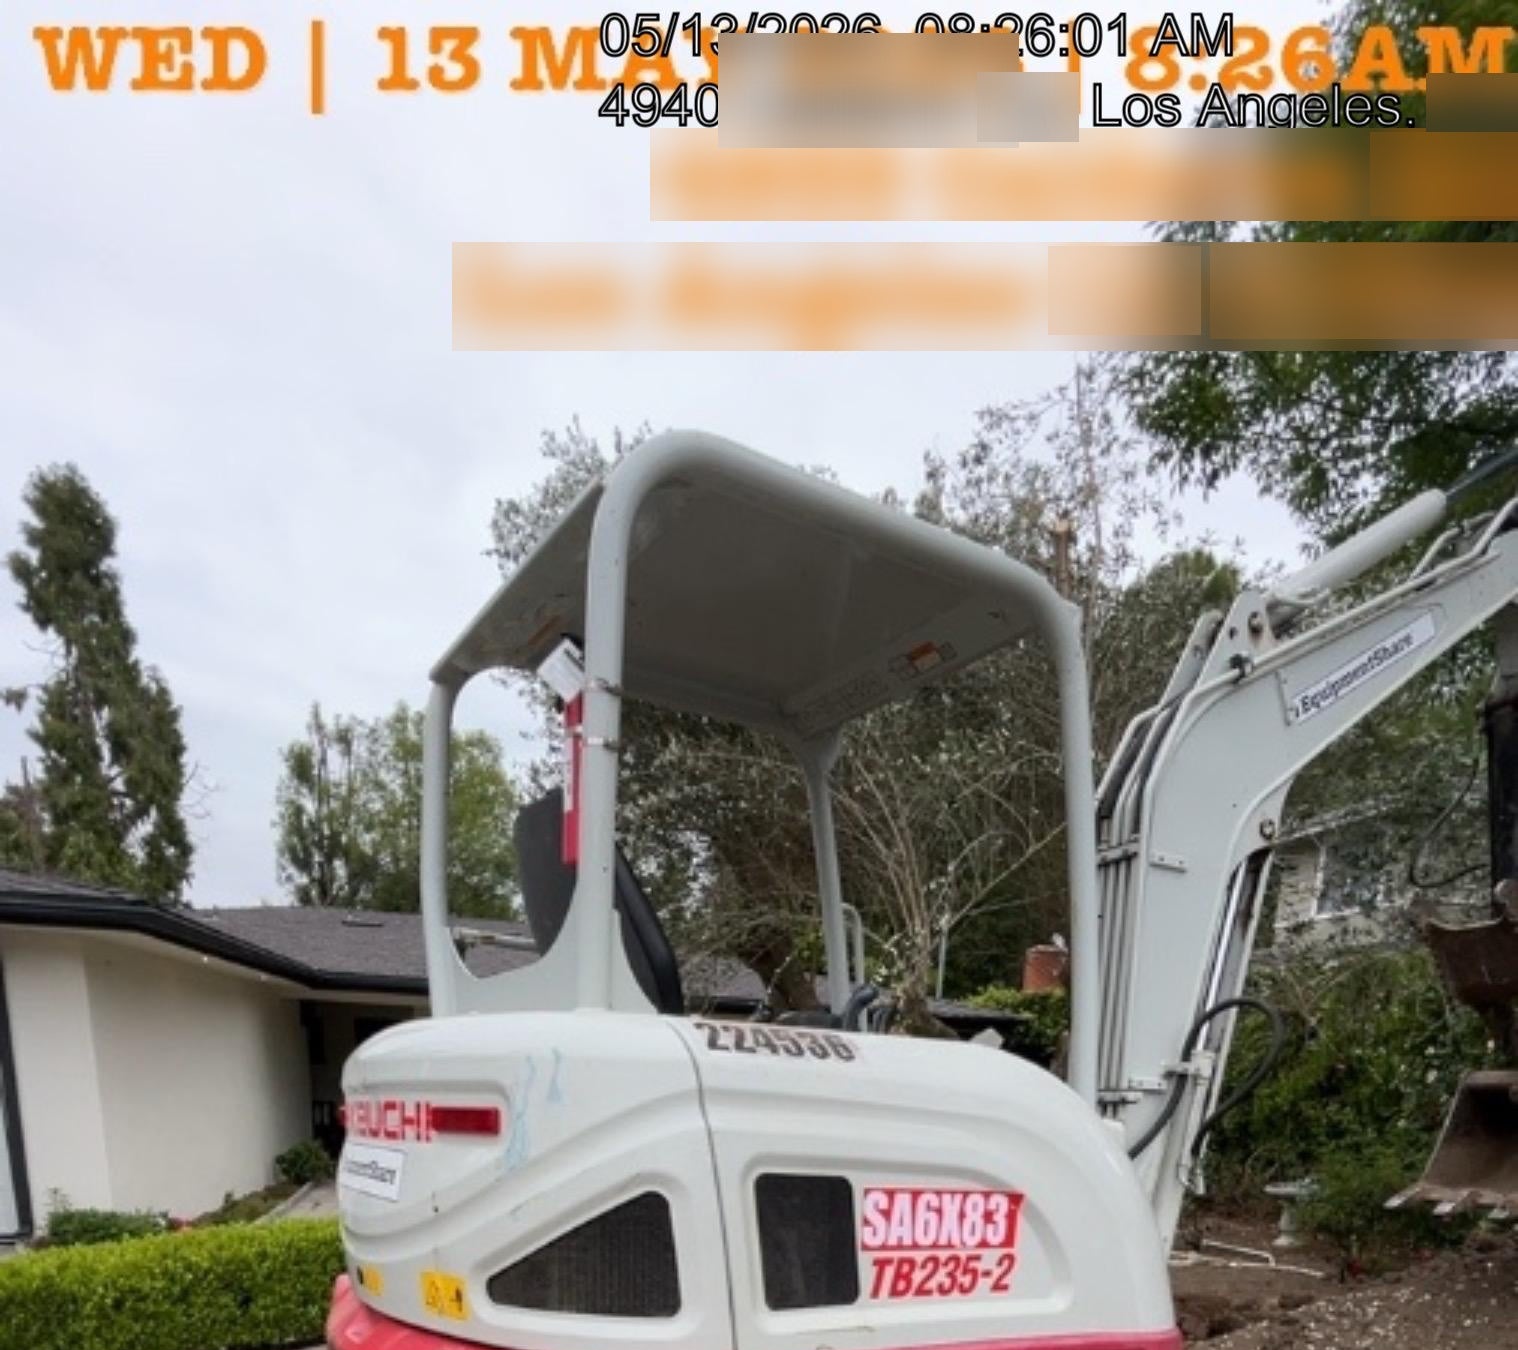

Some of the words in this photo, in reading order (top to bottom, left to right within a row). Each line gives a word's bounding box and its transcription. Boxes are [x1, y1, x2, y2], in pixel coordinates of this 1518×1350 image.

[1301, 632, 1413, 715] EquipmentShare
[694, 1022, 855, 1061] 224536
[863, 1190, 1009, 1248] SA6X83
[870, 1252, 1016, 1299] TB235-2
